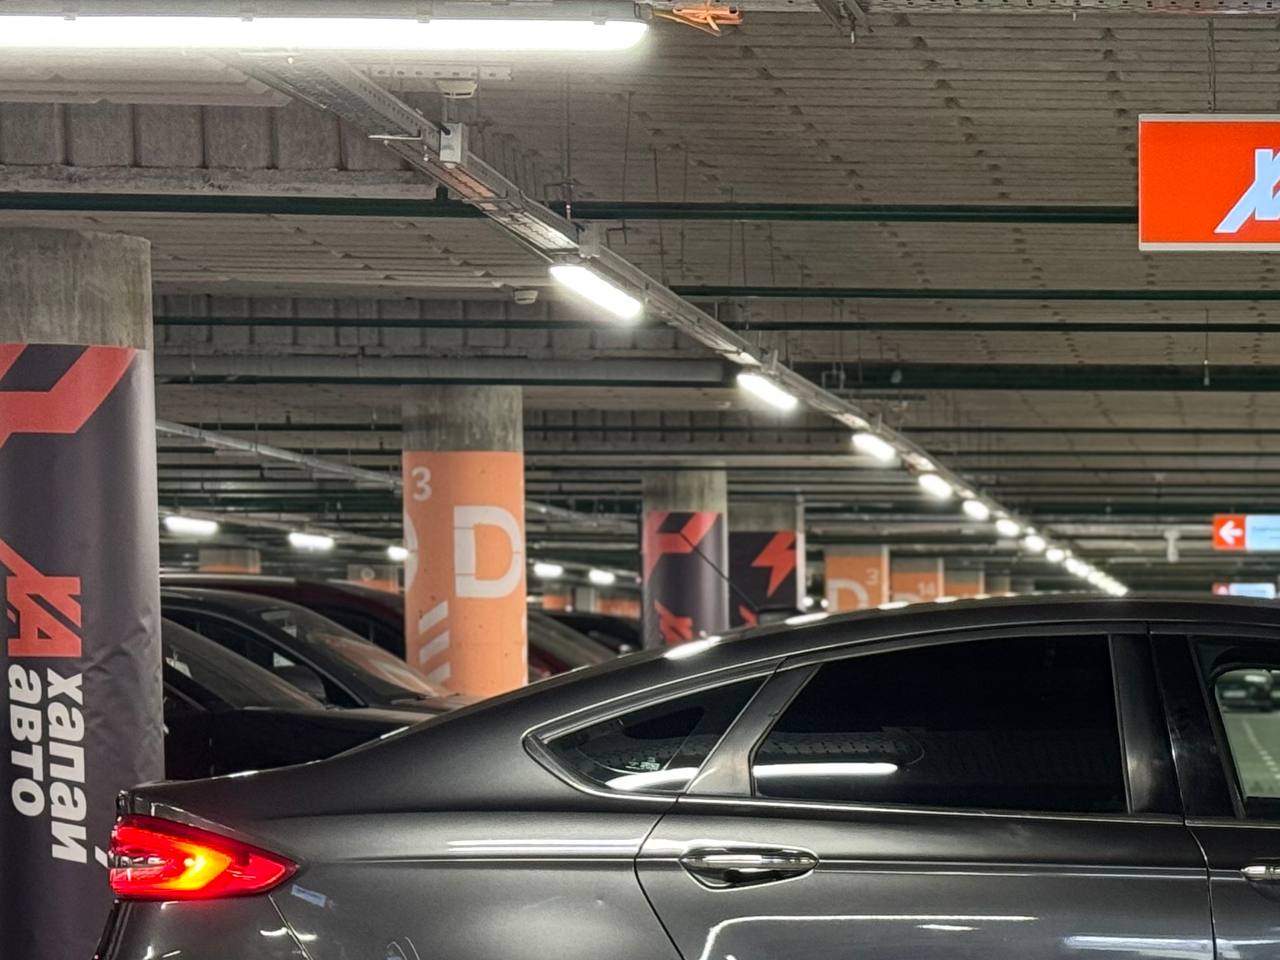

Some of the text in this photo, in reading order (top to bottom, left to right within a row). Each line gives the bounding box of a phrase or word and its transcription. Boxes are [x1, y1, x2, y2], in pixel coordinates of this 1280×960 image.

[411, 467, 433, 501] 3
[454, 505, 521, 598] D
[8, 664, 46, 817] авто
[48, 668, 109, 868] хапай
